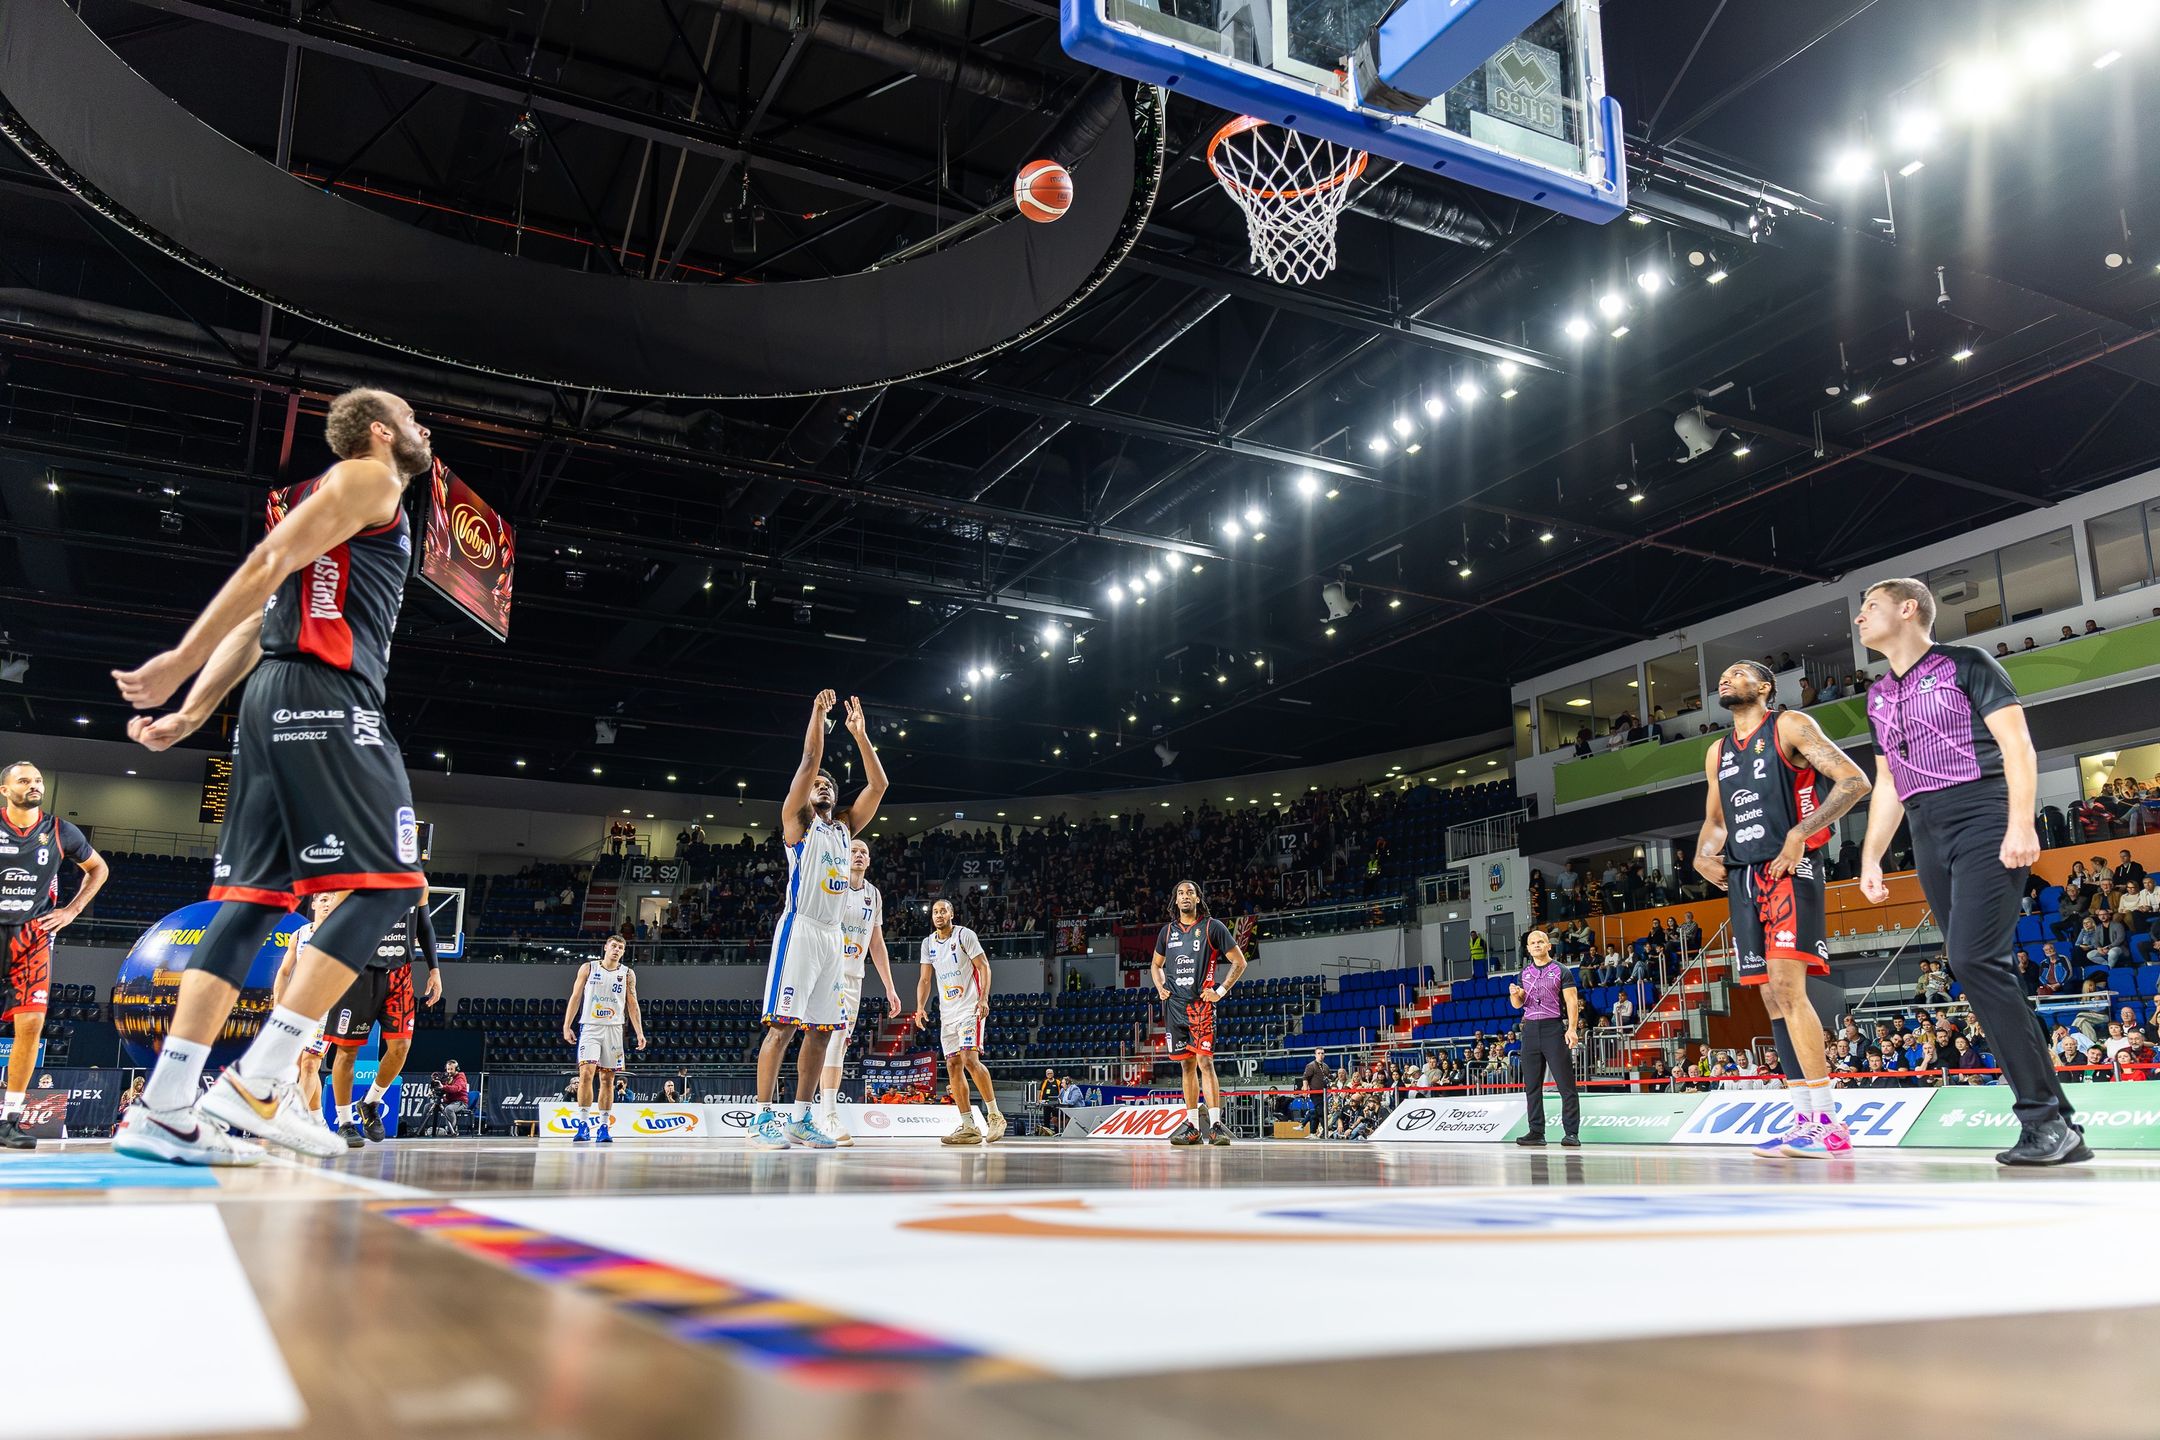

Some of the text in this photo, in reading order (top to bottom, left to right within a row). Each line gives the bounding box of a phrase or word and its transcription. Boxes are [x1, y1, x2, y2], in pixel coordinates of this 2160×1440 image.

[457, 511, 493, 560] Vobro
[292, 710, 345, 720] LEXUS
[273, 731, 328, 742] BYDGOSZCZ
[1753, 758, 1767, 779] 2
[1734, 792, 1760, 808] Enea
[1279, 834, 1297, 849] T2
[37, 848, 49, 866] 8
[632, 865, 679, 879] R2 S2
[962, 860, 981, 874] S2
[5, 872, 38, 882] Enea
[862, 907, 873, 921] 77
[1193, 940, 1200, 951] 9
[952, 953, 958, 964] 1
[612, 983, 622, 994] 35
[596, 1009, 612, 1018] LOTTO
[1091, 1064, 1138, 1081] T1 U1
[1236, 1060, 1258, 1078] VIP
[1448, 1109, 1489, 1120] Toyota
[1591, 1115, 1672, 1128] ZDROWIA
[645, 1116, 687, 1130] LOTTO
[1092, 1109, 1188, 1135] ANIRO
[1435, 1121, 1500, 1134] Bednarscy
